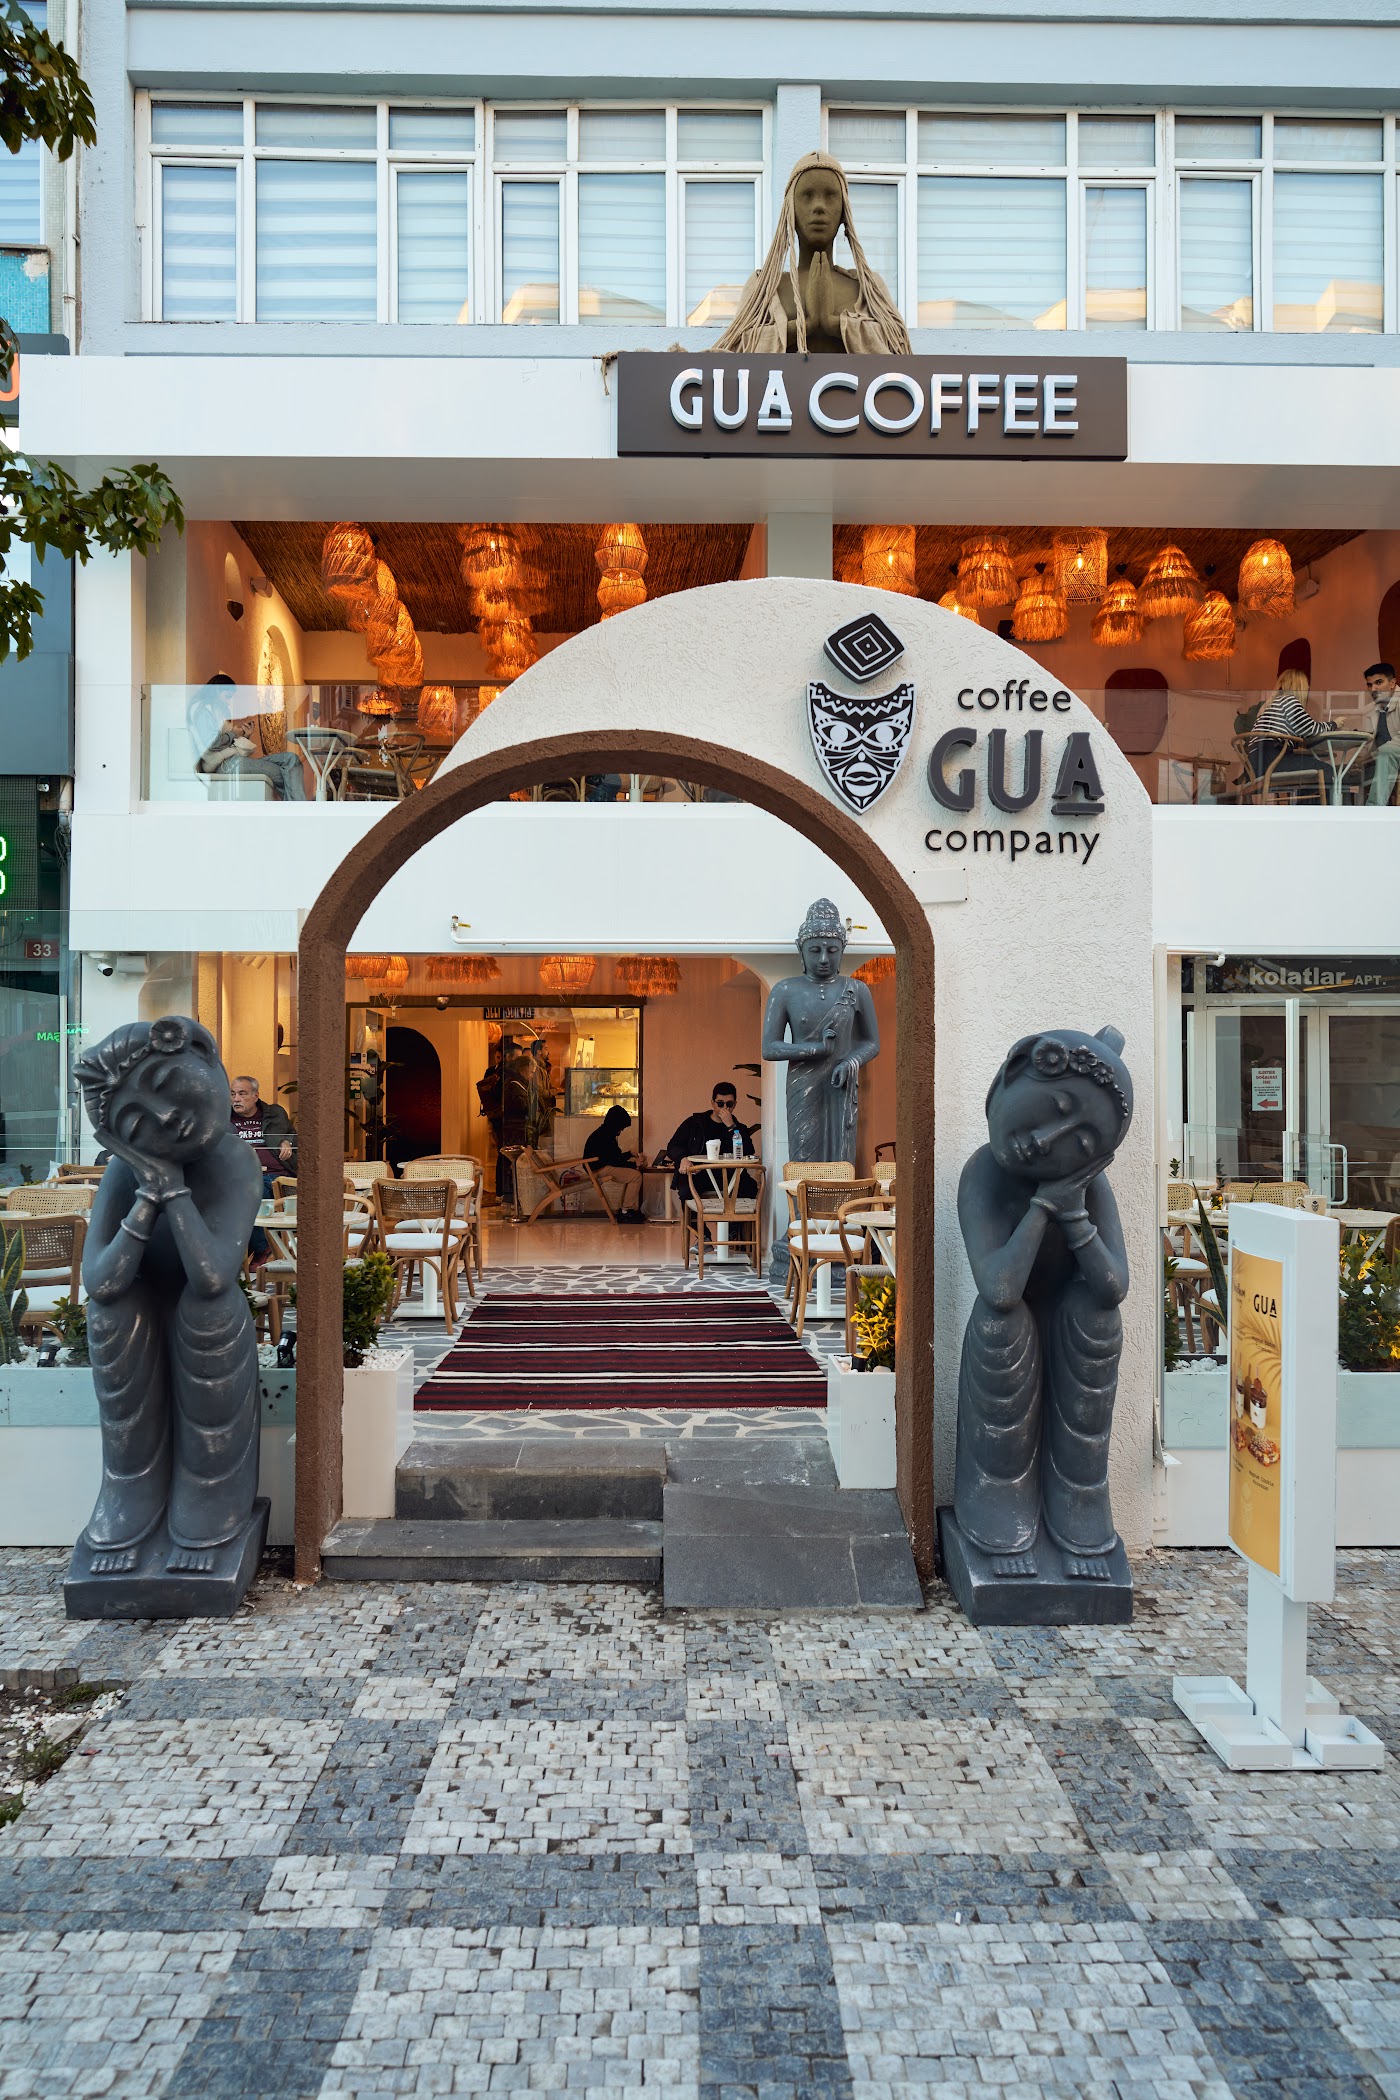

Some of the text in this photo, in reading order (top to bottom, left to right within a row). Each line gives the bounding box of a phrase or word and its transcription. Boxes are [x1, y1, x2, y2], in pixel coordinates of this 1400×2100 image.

[669, 368, 1079, 434] GUA COFFEE
[957, 679, 1072, 712] coffee
[927, 727, 1105, 816] GUA
[925, 829, 1100, 865] company
[32, 943, 52, 957] 33
[1250, 967, 1387, 986] kolatlar APT.
[1253, 1293, 1277, 1319] GUA
